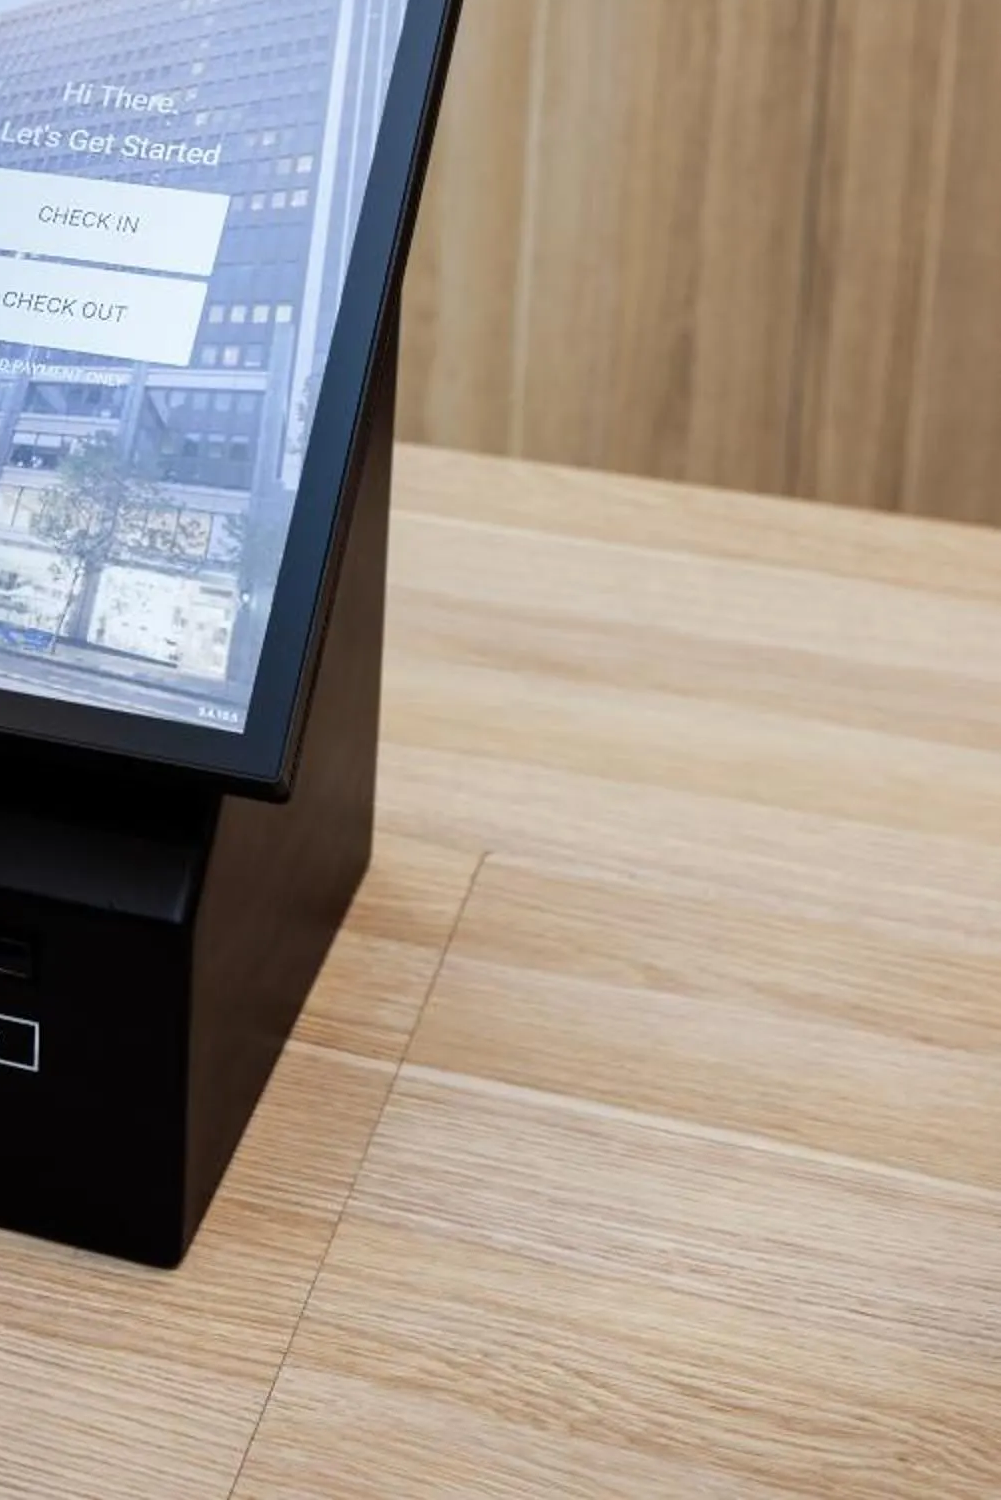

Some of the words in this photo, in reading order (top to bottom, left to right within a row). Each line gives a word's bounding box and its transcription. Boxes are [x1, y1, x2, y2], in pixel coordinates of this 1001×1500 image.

[63, 81, 93, 106] Hi
[1, 121, 63, 148] Let's
[69, 129, 116, 154] Get
[120, 134, 222, 167] Started
[38, 205, 112, 230] CHECK
[115, 216, 140, 234] IN
[1, 290, 77, 316] CHECK
[82, 302, 129, 323] OUT
